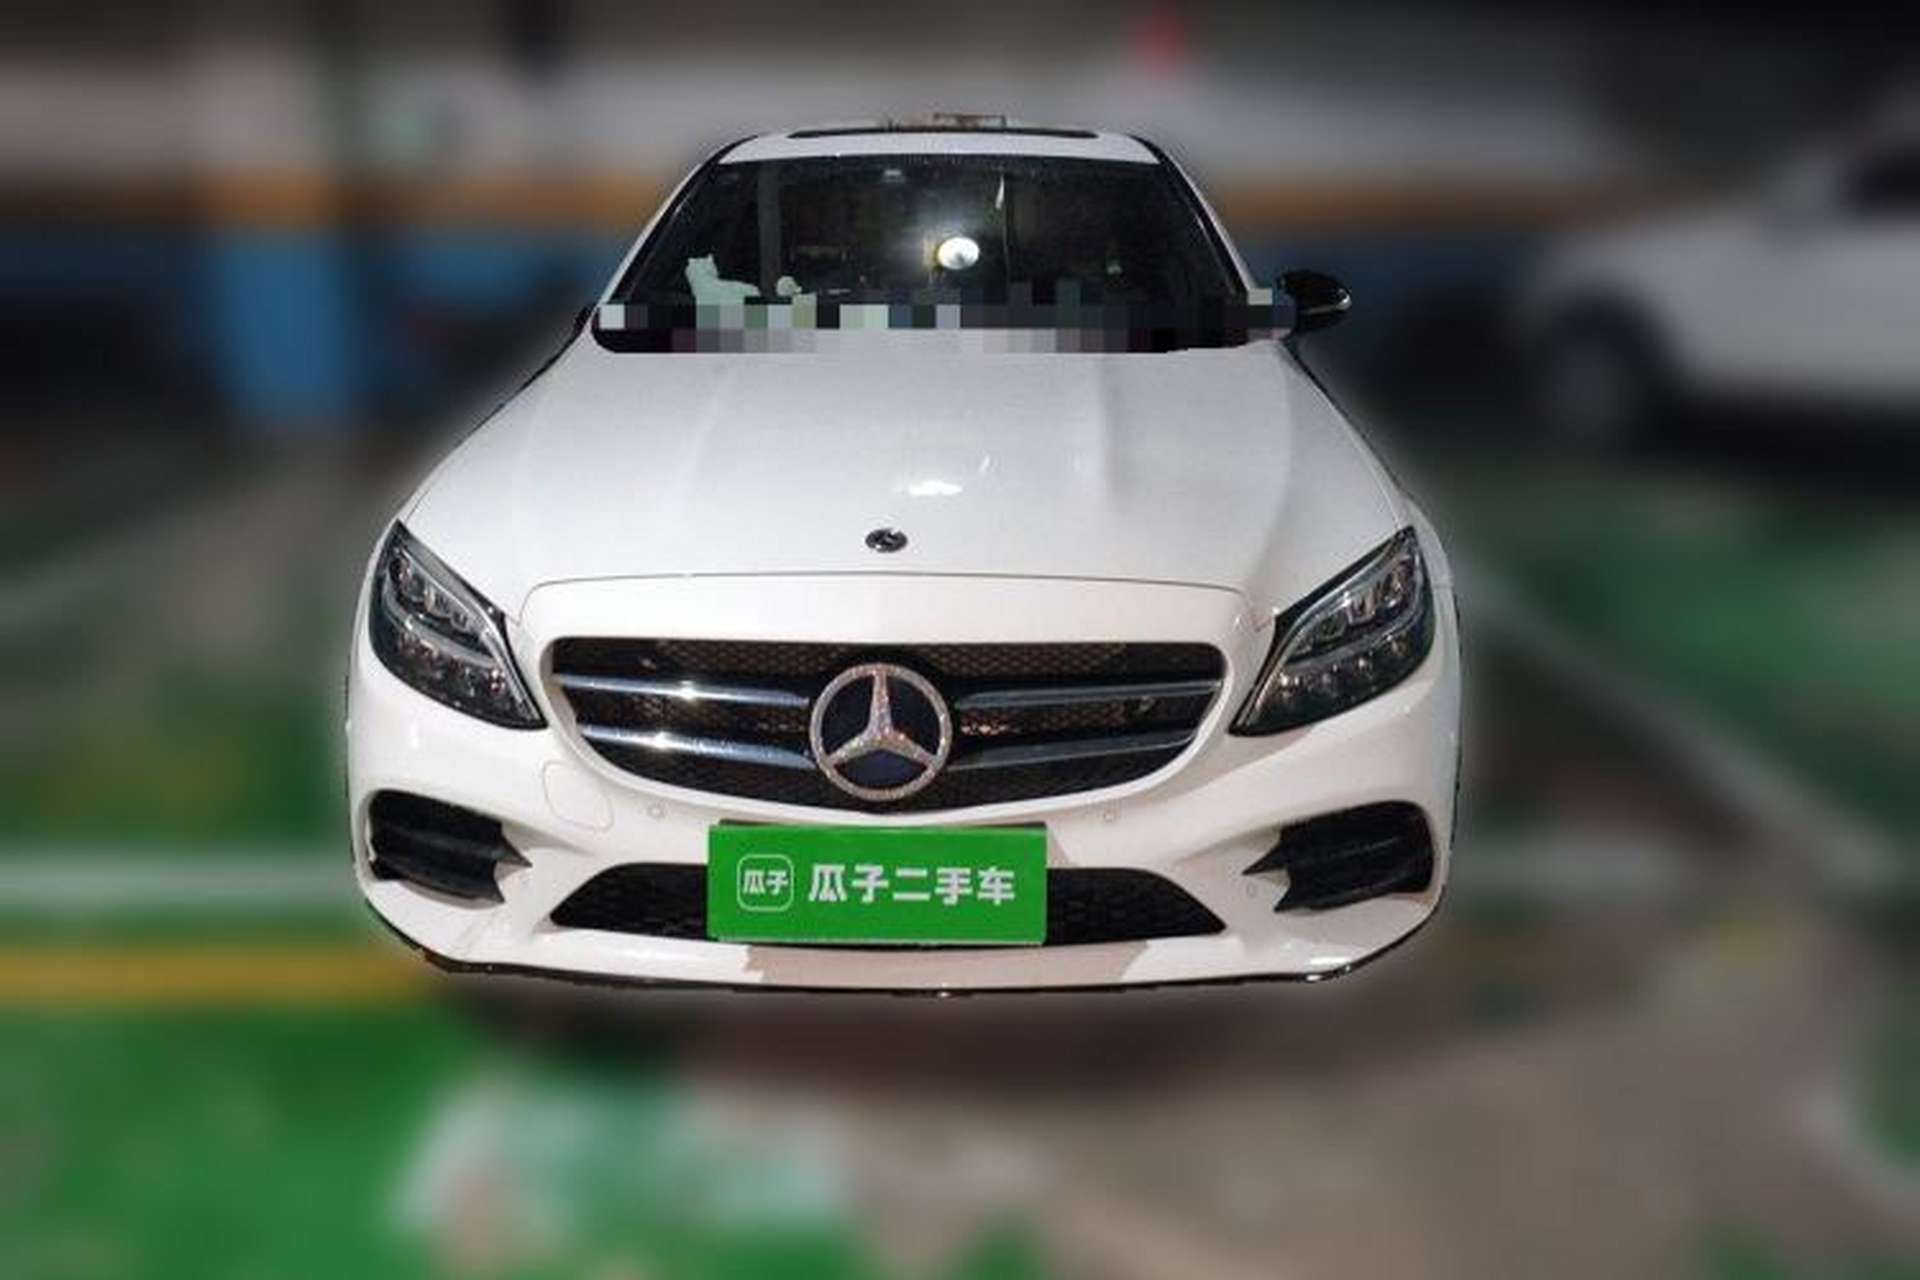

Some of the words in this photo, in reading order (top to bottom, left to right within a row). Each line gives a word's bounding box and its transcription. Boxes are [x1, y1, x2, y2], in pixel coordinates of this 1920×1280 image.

[744, 870, 788, 895] 瓜子
[808, 864, 1015, 905] 瓜子二手车
